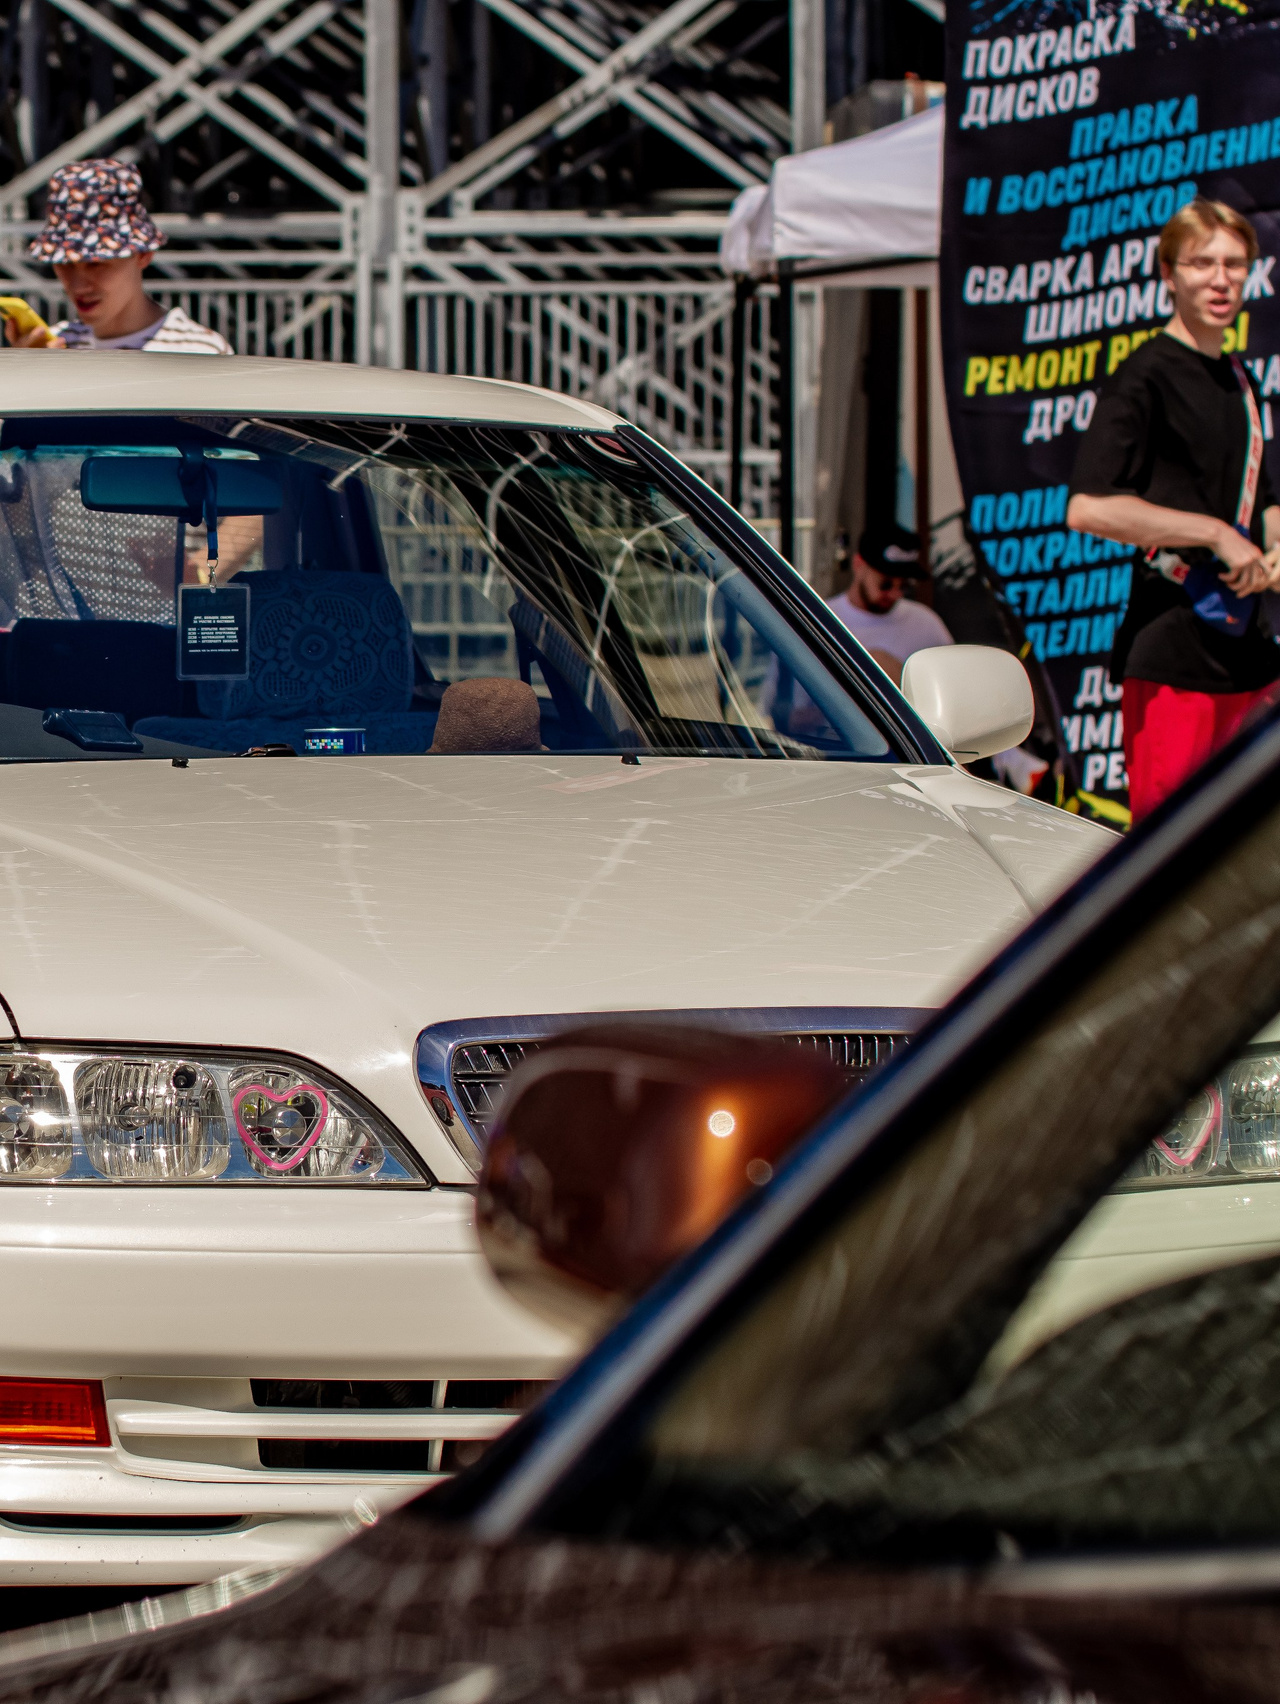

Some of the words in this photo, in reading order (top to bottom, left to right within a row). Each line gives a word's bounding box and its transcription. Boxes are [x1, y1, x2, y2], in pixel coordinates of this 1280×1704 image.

[962, 14, 1136, 80] ПОКРАСКА
[960, 66, 1101, 129] ДИСКОВ
[1069, 94, 1198, 159] ПРАВКА
[963, 177, 991, 215] И
[963, 251, 1094, 305] СВАРКА
[1099, 235, 1162, 285] АРГ
[964, 339, 1102, 397] РЕМОНТ
[971, 484, 1069, 533] ПОЛИ
